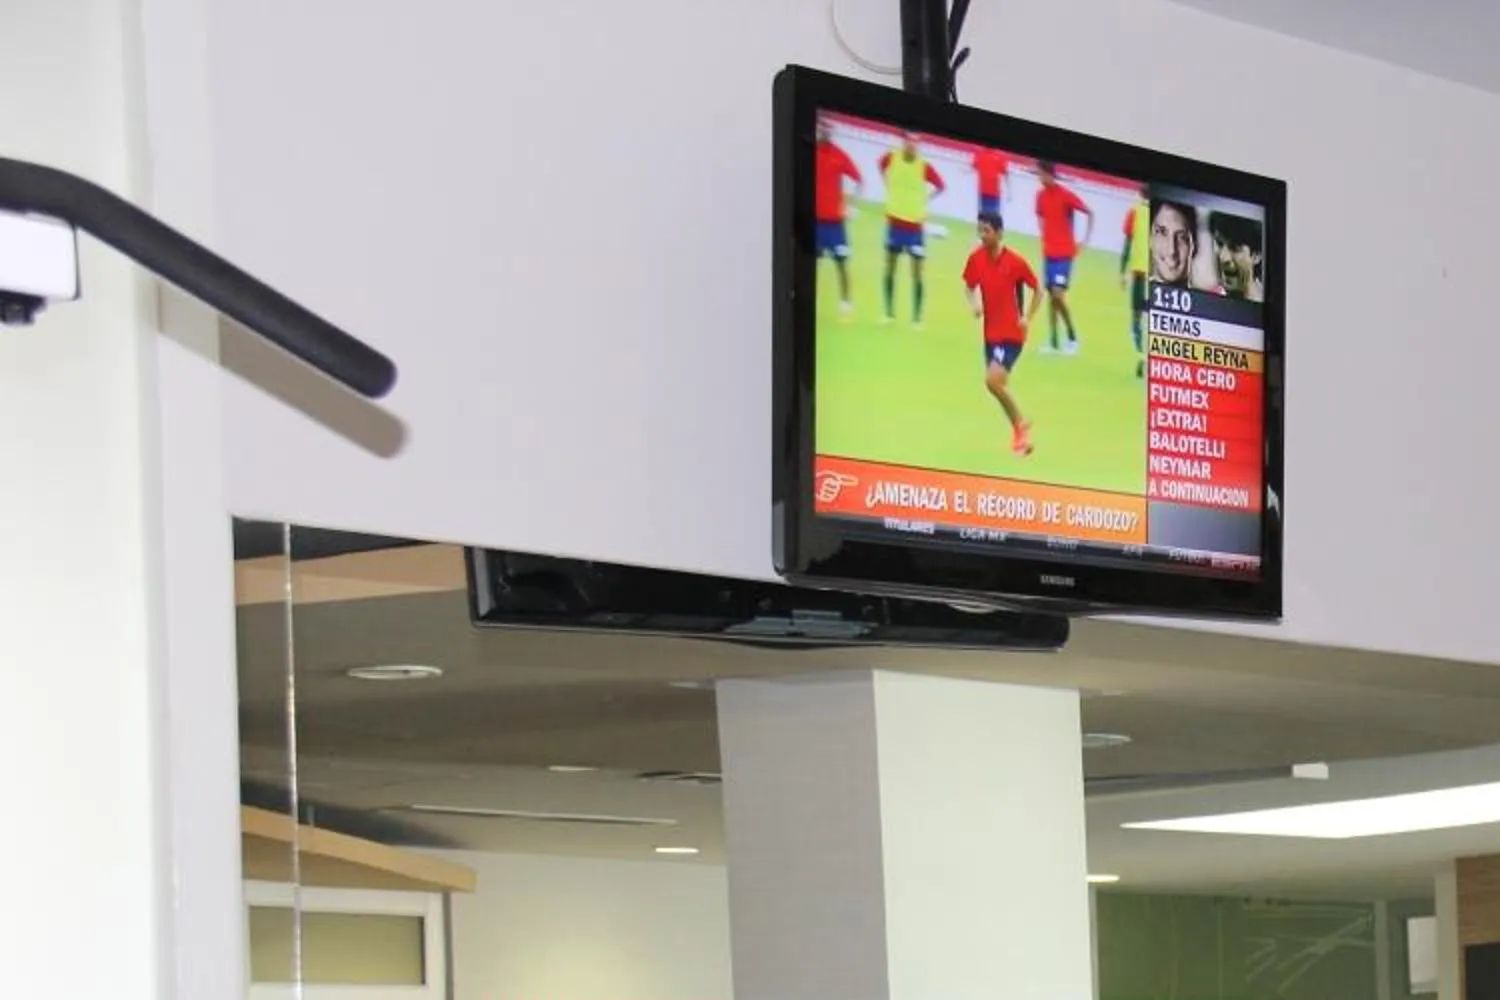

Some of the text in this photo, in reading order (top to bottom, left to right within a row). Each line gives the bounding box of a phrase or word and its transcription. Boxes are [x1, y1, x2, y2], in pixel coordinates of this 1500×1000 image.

[1154, 287, 1191, 312] 1:10
[1152, 313, 1201, 337] TEMAS
[1151, 338, 1249, 369] ANGEL REYNA
[1150, 359, 1236, 391] HORA CERO
[1150, 383, 1209, 409] FUTMEX
[1150, 431, 1226, 459] BALOTELLI
[1150, 454, 1212, 480] NEYMAR
[1150, 479, 1159, 496] A
[865, 480, 948, 511] ¿AMENAZA
[954, 490, 971, 514] EL
[1042, 500, 1061, 524] DE
[1065, 504, 1139, 533] CARDOZO?
